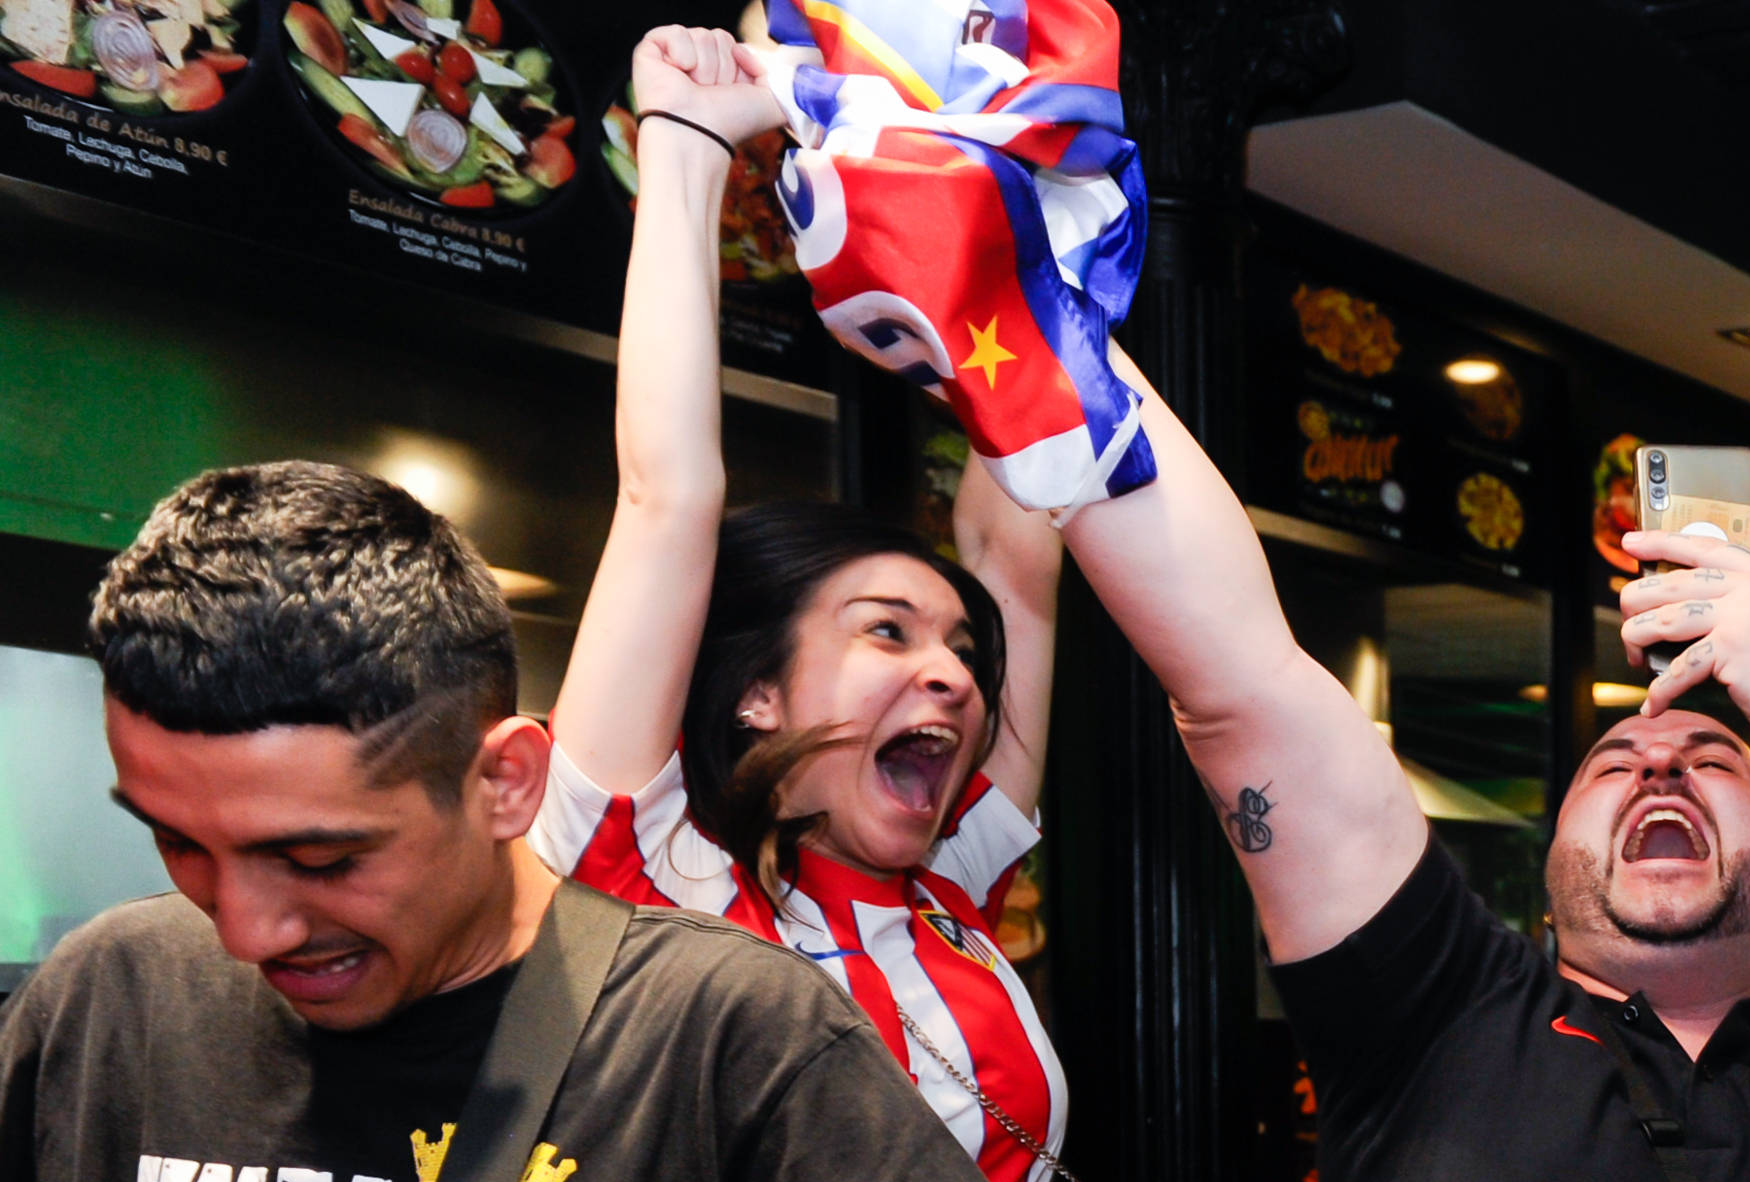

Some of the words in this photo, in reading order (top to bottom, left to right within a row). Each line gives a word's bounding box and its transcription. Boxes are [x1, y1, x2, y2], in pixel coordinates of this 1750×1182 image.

[0, 91, 79, 124] nsalada
[86, 111, 111, 133] de
[118, 122, 169, 149] Atún
[173, 137, 212, 161] 8.90
[216, 150, 228, 167] €
[348, 189, 424, 223] Ensalada
